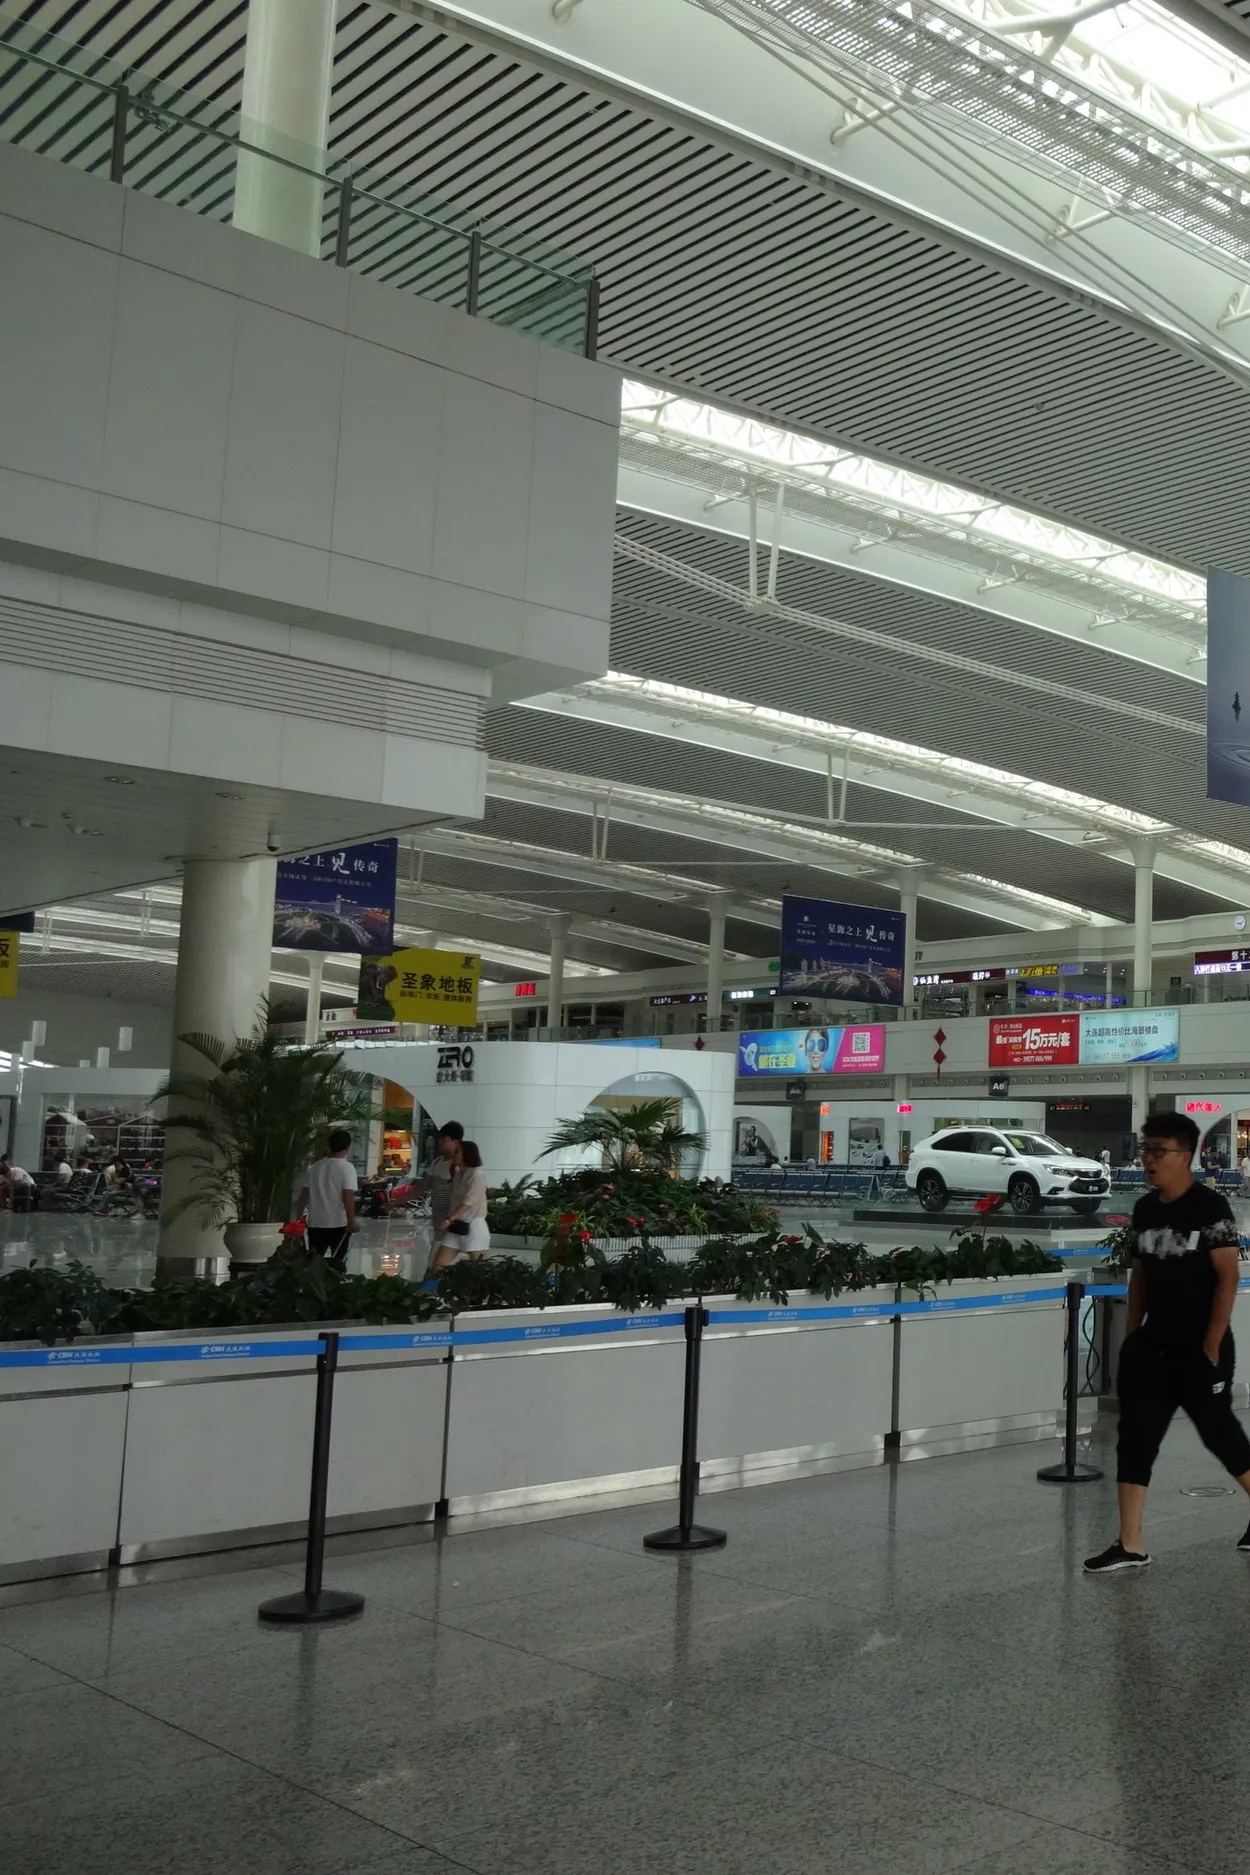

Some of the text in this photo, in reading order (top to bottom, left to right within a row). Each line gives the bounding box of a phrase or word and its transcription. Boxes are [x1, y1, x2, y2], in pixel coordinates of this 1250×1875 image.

[401, 972, 473, 994] 圣象地板
[993, 1082, 1004, 1090] A6
